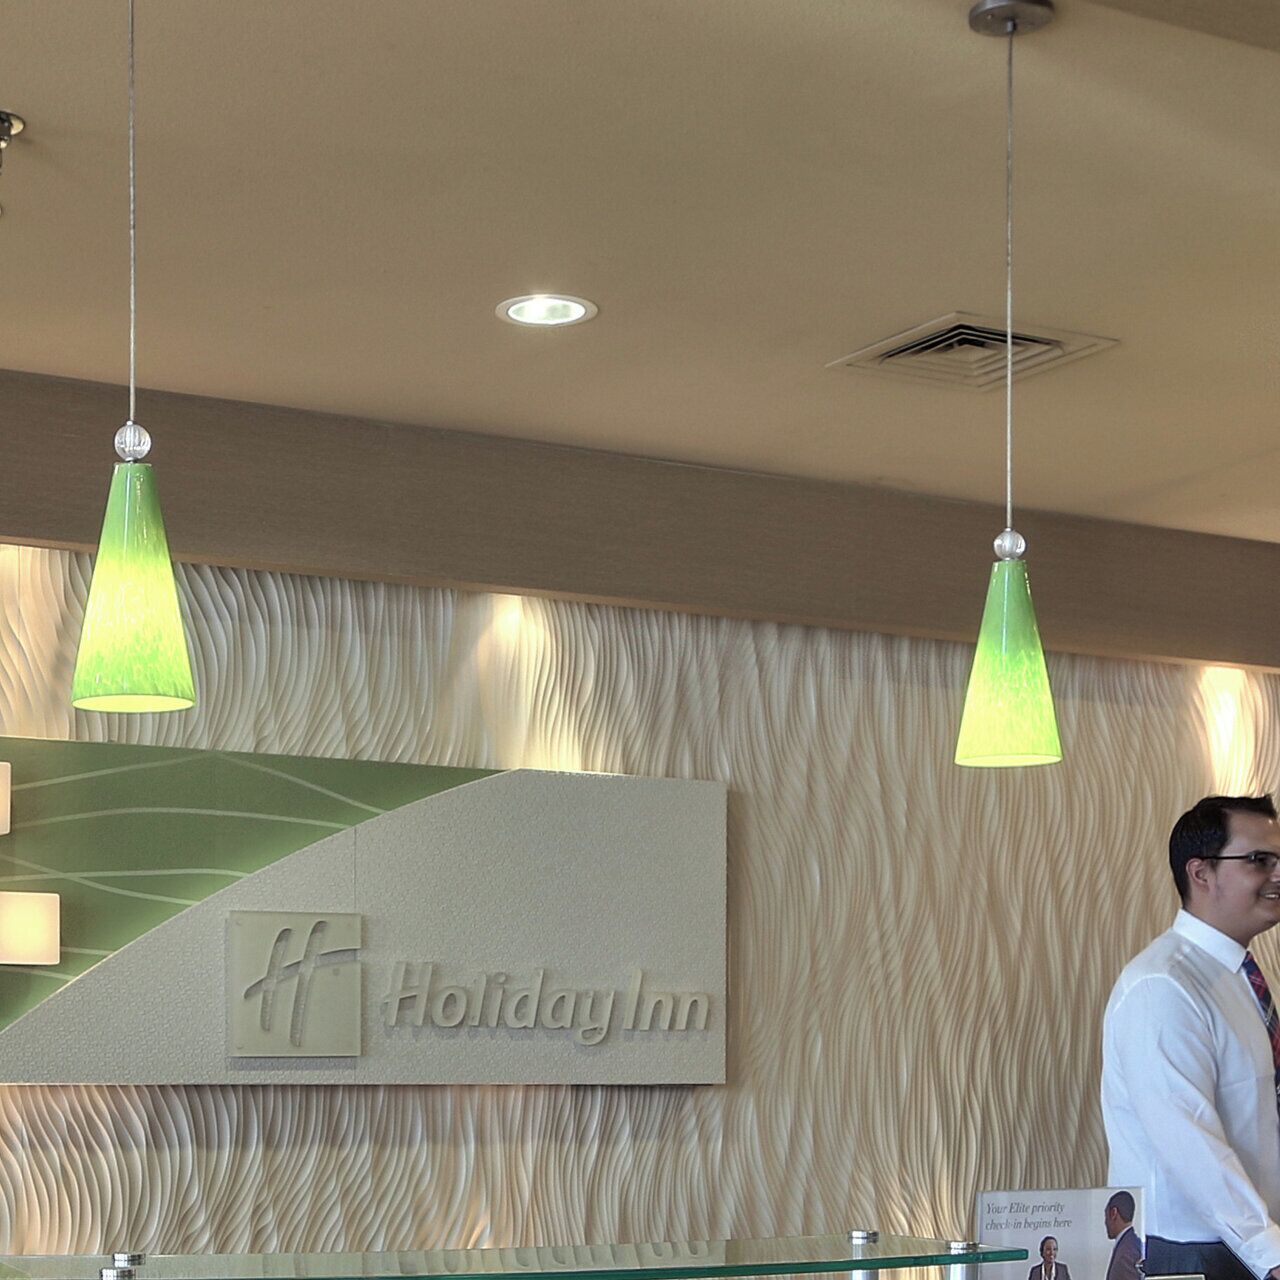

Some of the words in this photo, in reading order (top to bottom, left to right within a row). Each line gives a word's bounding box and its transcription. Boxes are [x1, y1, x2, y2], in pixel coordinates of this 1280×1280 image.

[382, 959, 615, 1046] Holiday
[623, 967, 710, 1031] Inn
[987, 1202, 1007, 1214] Your
[1009, 1202, 1030, 1214] Elite
[1031, 1201, 1065, 1215] priority
[985, 1219, 1022, 1231] check-in
[1024, 1217, 1052, 1231] begins
[1053, 1217, 1072, 1228] here
